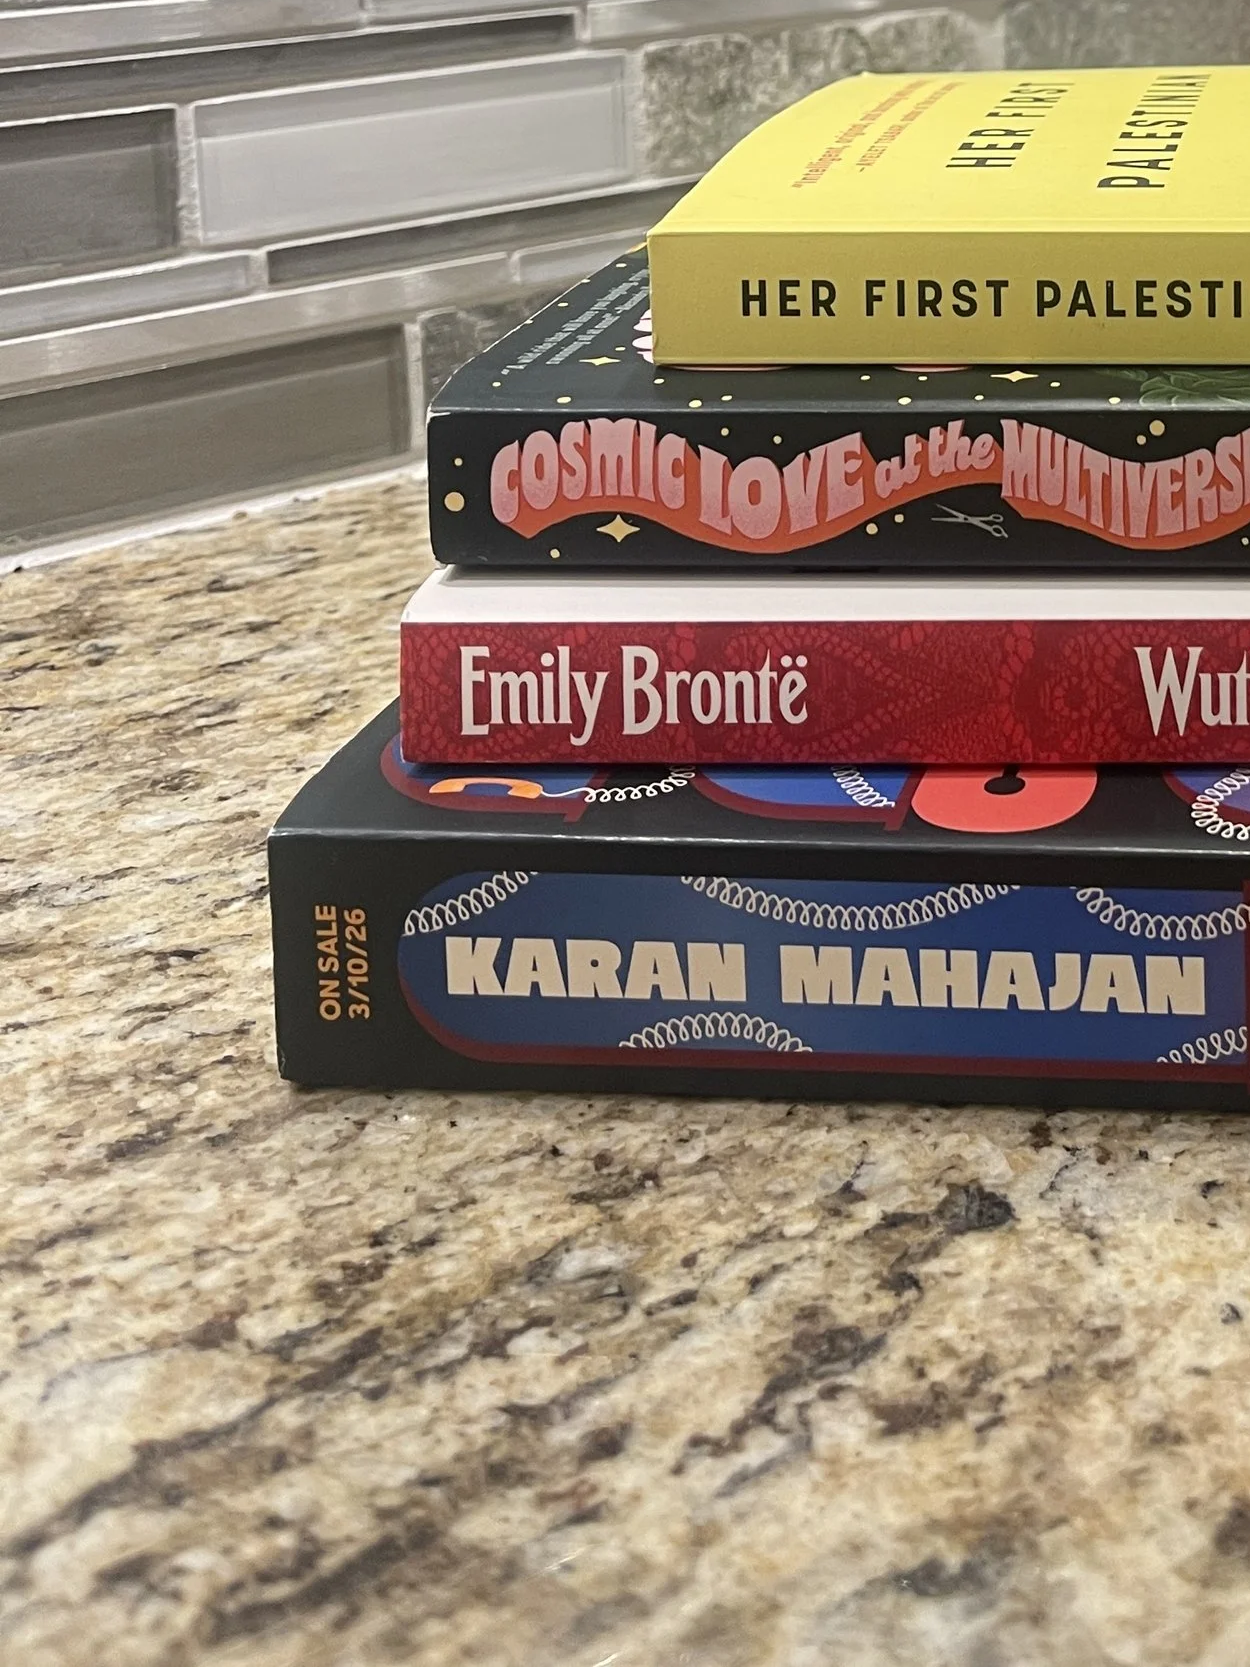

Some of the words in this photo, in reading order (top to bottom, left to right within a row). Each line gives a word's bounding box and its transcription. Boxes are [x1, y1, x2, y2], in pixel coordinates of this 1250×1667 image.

[985, 82, 1076, 118] FIRST
[1096, 73, 1212, 188] PALESTINIAN
[945, 128, 1035, 168] HER
[741, 279, 836, 318] HER
[865, 279, 1010, 318] FIRST
[490, 417, 686, 524] COSMIC
[698, 431, 864, 539] LOVE
[874, 433, 922, 499] at
[928, 419, 996, 477] the
[460, 645, 609, 746] Emily
[621, 645, 808, 735] Brontë
[315, 904, 339, 974] SALE
[343, 908, 371, 1020] 3/10/26
[445, 935, 747, 1002] KARAN
[780, 945, 1205, 1015] MAHAJAN
[317, 977, 340, 1021] ON
